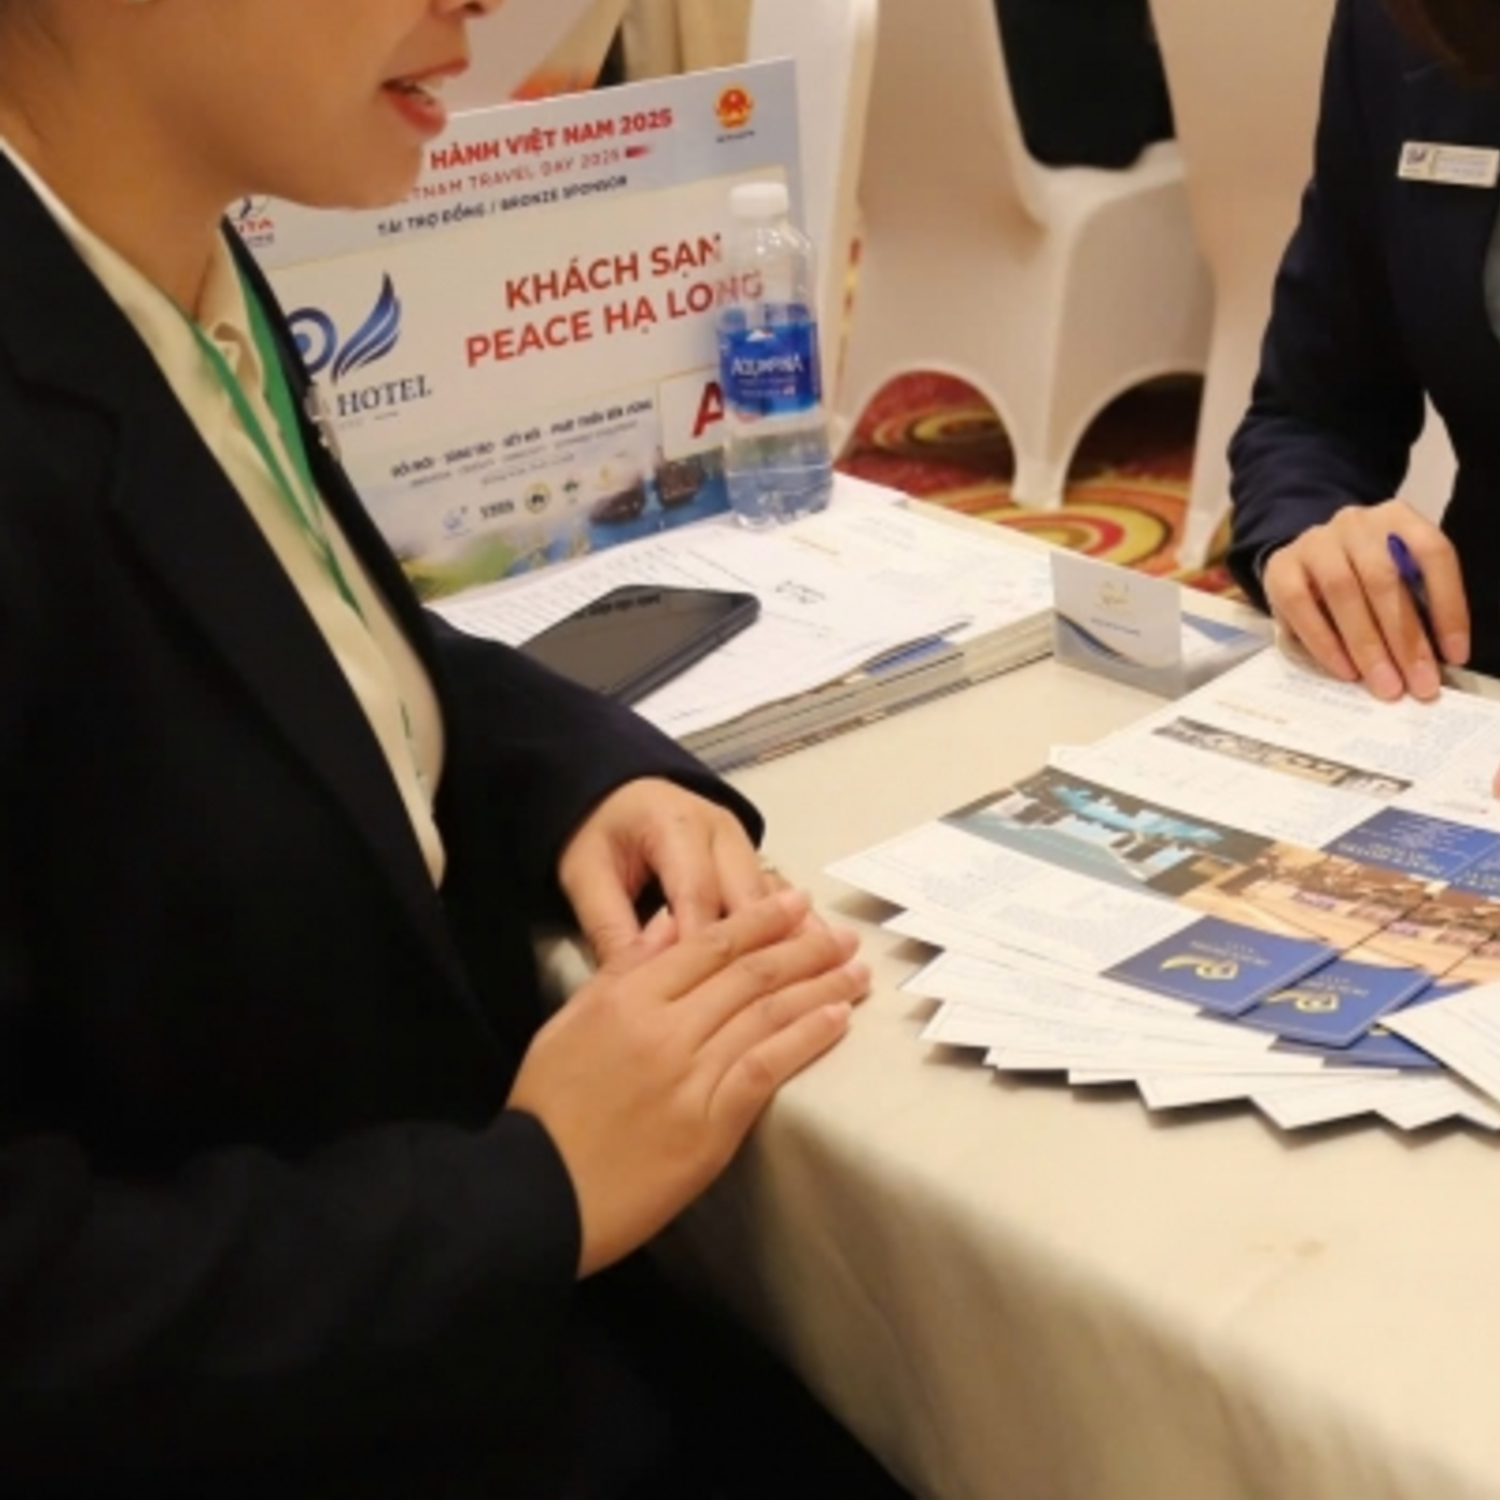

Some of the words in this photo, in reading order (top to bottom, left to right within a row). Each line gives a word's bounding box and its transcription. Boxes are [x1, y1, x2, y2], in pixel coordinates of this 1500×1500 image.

[430, 141, 500, 171] HÀNH
[506, 126, 556, 157] VIỆT
[562, 118, 615, 146] NAM
[620, 107, 673, 135] 2025
[411, 178, 462, 199] TNAM
[469, 165, 534, 190] TRAVEL
[540, 156, 574, 177] DAY
[581, 148, 620, 170] 2025
[501, 187, 557, 211] BRONZE
[562, 175, 628, 200] SPONSOR
[504, 252, 640, 311] KHÁCH
[465, 309, 594, 369] PEACE
[603, 296, 658, 335] HẠ
[666, 269, 764, 320] LONG
[337, 374, 433, 418] HOTEL
